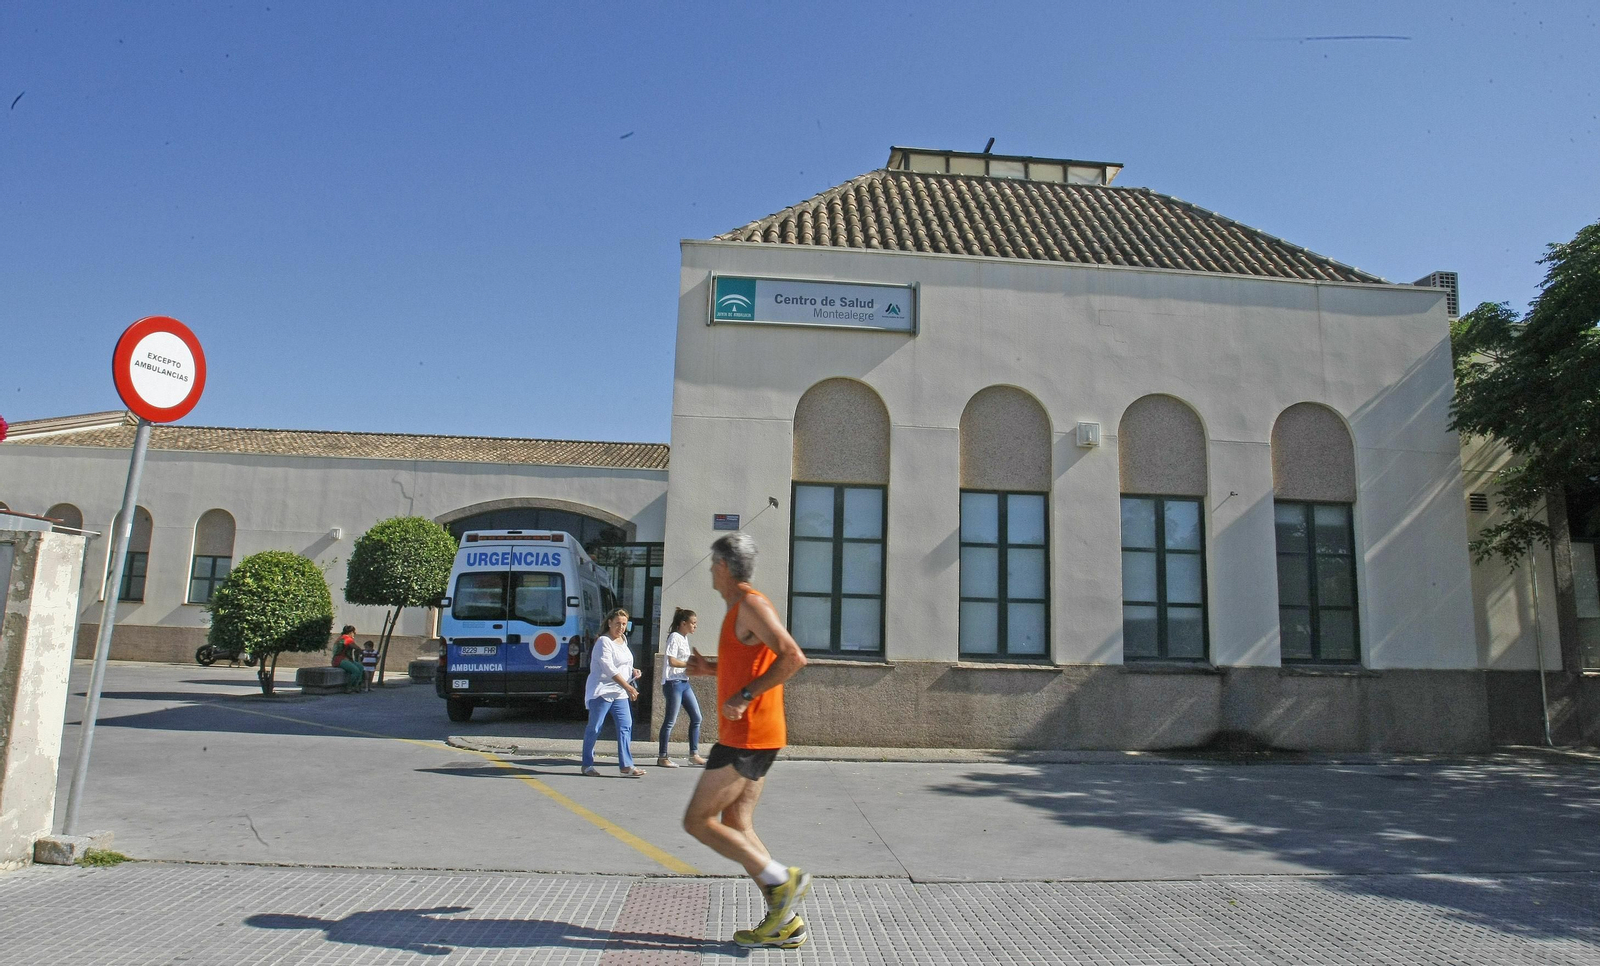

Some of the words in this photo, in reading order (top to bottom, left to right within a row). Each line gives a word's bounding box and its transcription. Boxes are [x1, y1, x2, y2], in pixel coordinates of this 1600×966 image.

[774, 293, 817, 306] Centro
[820, 295, 835, 306] de
[839, 297, 874, 309] Salud
[813, 308, 874, 322] Montealegre
[147, 352, 181, 368] EXCEPTO
[134, 360, 189, 382] AMBULANCIAS
[467, 552, 561, 566] URGENCIAS
